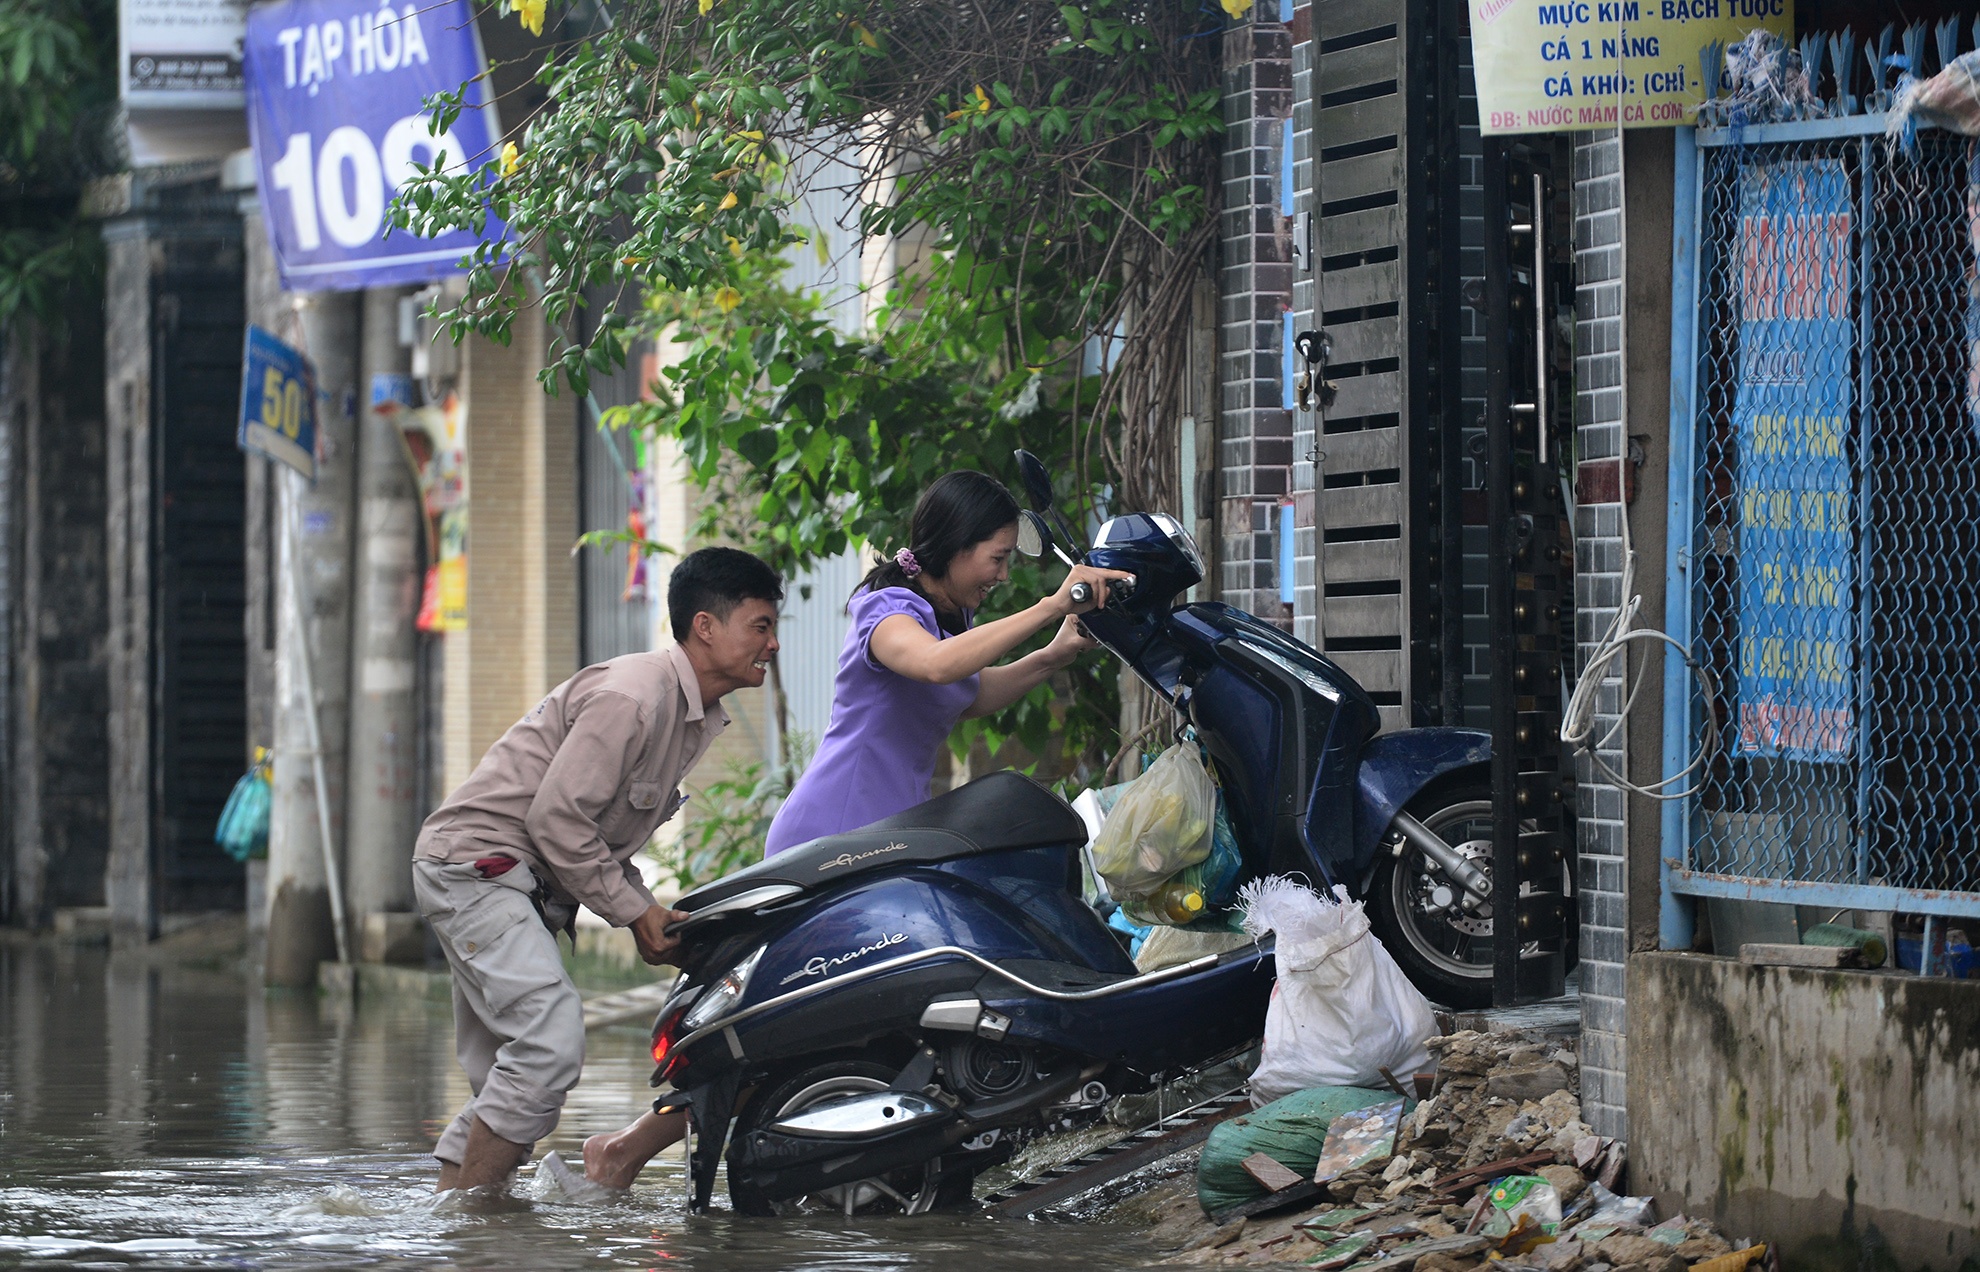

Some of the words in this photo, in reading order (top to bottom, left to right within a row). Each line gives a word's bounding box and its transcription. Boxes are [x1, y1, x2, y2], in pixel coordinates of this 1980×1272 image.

[1538, 1, 1590, 28] MỰC
[1598, 2, 1640, 22] KIM
[1662, 0, 1719, 23] BẠCH
[276, 19, 344, 98] TẠP
[350, 0, 430, 77] HÓA
[1541, 35, 1571, 61] CÁ
[1581, 40, 1593, 59] 1
[1602, 29, 1659, 58] NẮNG
[1544, 72, 1573, 97] CÁ
[1582, 69, 1635, 96] KHÔ:
[1644, 65, 1685, 95] (CHỈ
[1490, 112, 1521, 128] ĐB:
[1528, 104, 1573, 126] NƯỚC
[1579, 99, 1618, 123] MẮM
[1624, 101, 1645, 121] CÁ
[1651, 101, 1682, 121] CƠM
[836, 841, 908, 866] Grande
[804, 932, 909, 976] Grande
